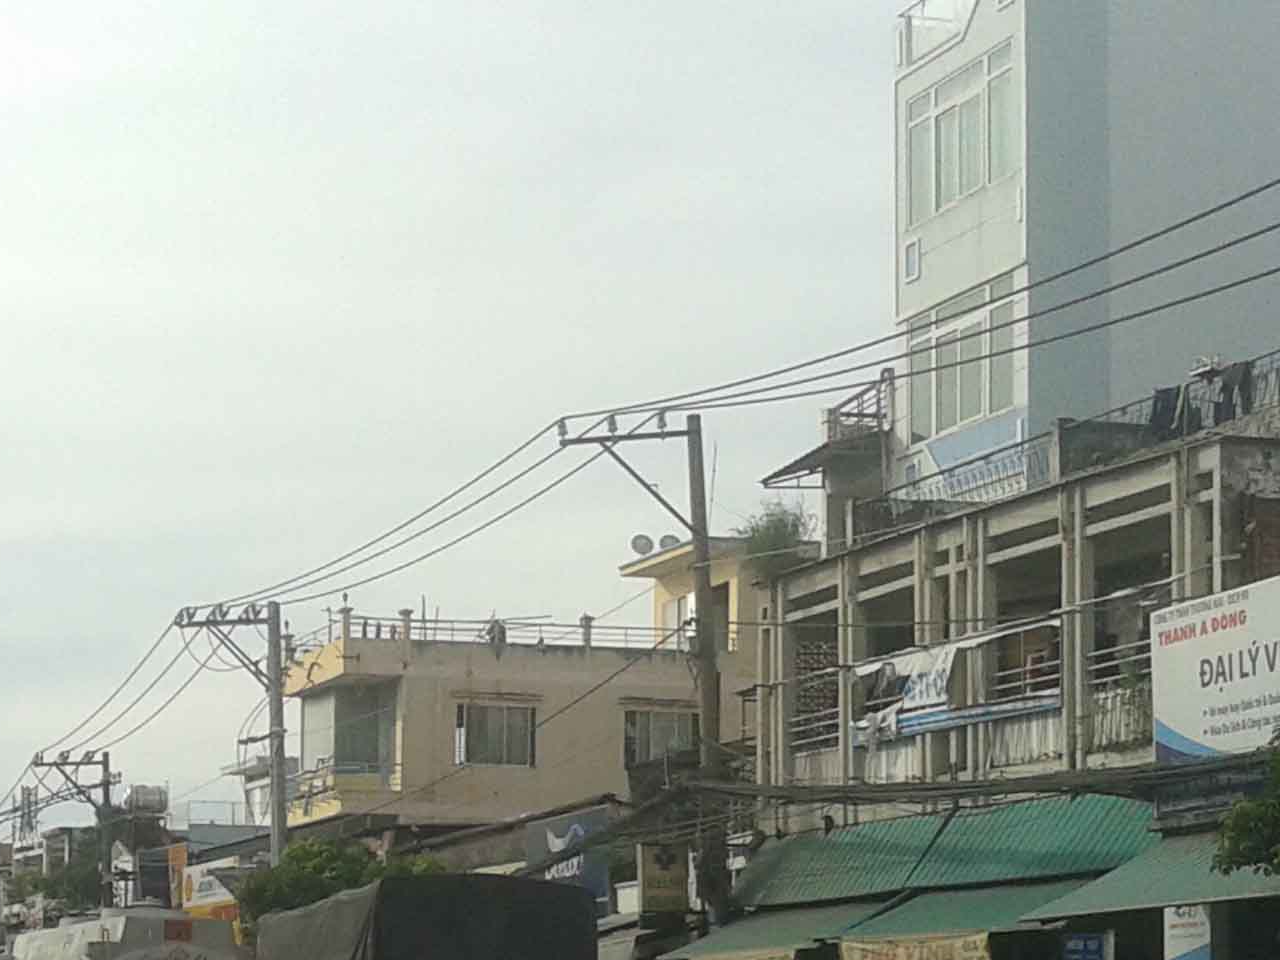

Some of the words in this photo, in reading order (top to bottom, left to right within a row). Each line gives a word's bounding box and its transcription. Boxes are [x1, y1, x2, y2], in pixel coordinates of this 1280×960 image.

[1157, 622, 1197, 647] THANH
[1199, 653, 1233, 692] ĐẠI
[1239, 639, 1261, 679] LÝ
